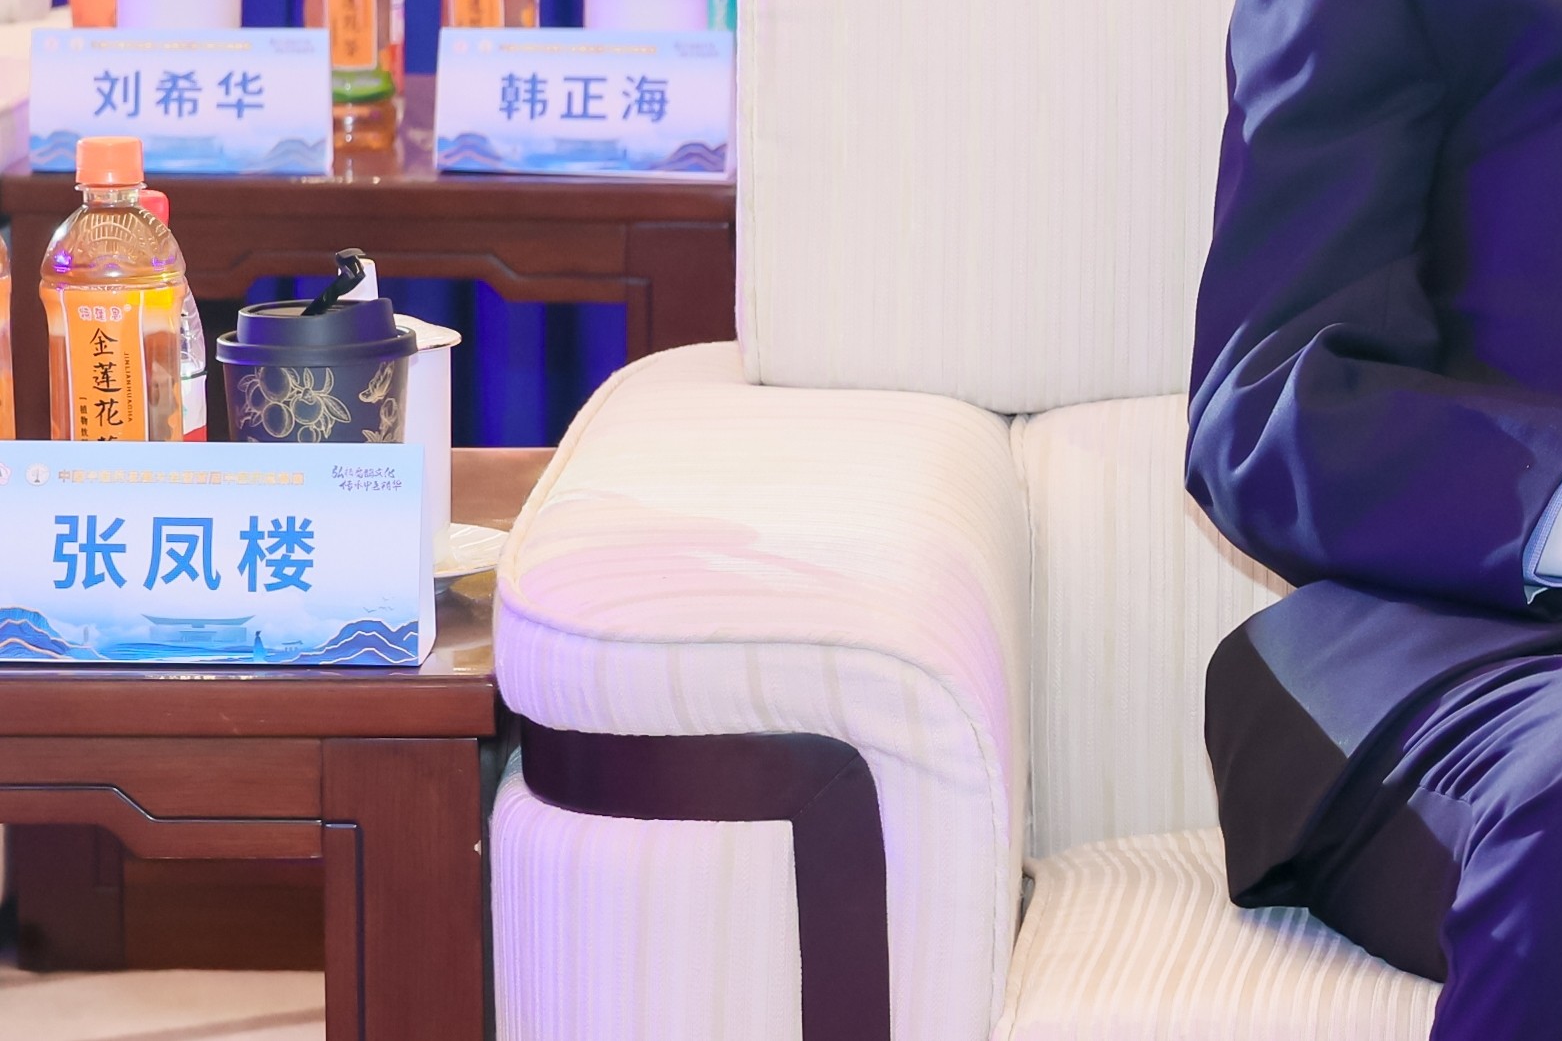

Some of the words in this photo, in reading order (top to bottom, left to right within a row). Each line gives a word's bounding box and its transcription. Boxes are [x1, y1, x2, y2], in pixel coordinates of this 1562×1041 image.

[93, 69, 265, 119] 刘希华
[499, 72, 669, 122] 韩正海
[53, 515, 316, 593] 张凤楼
